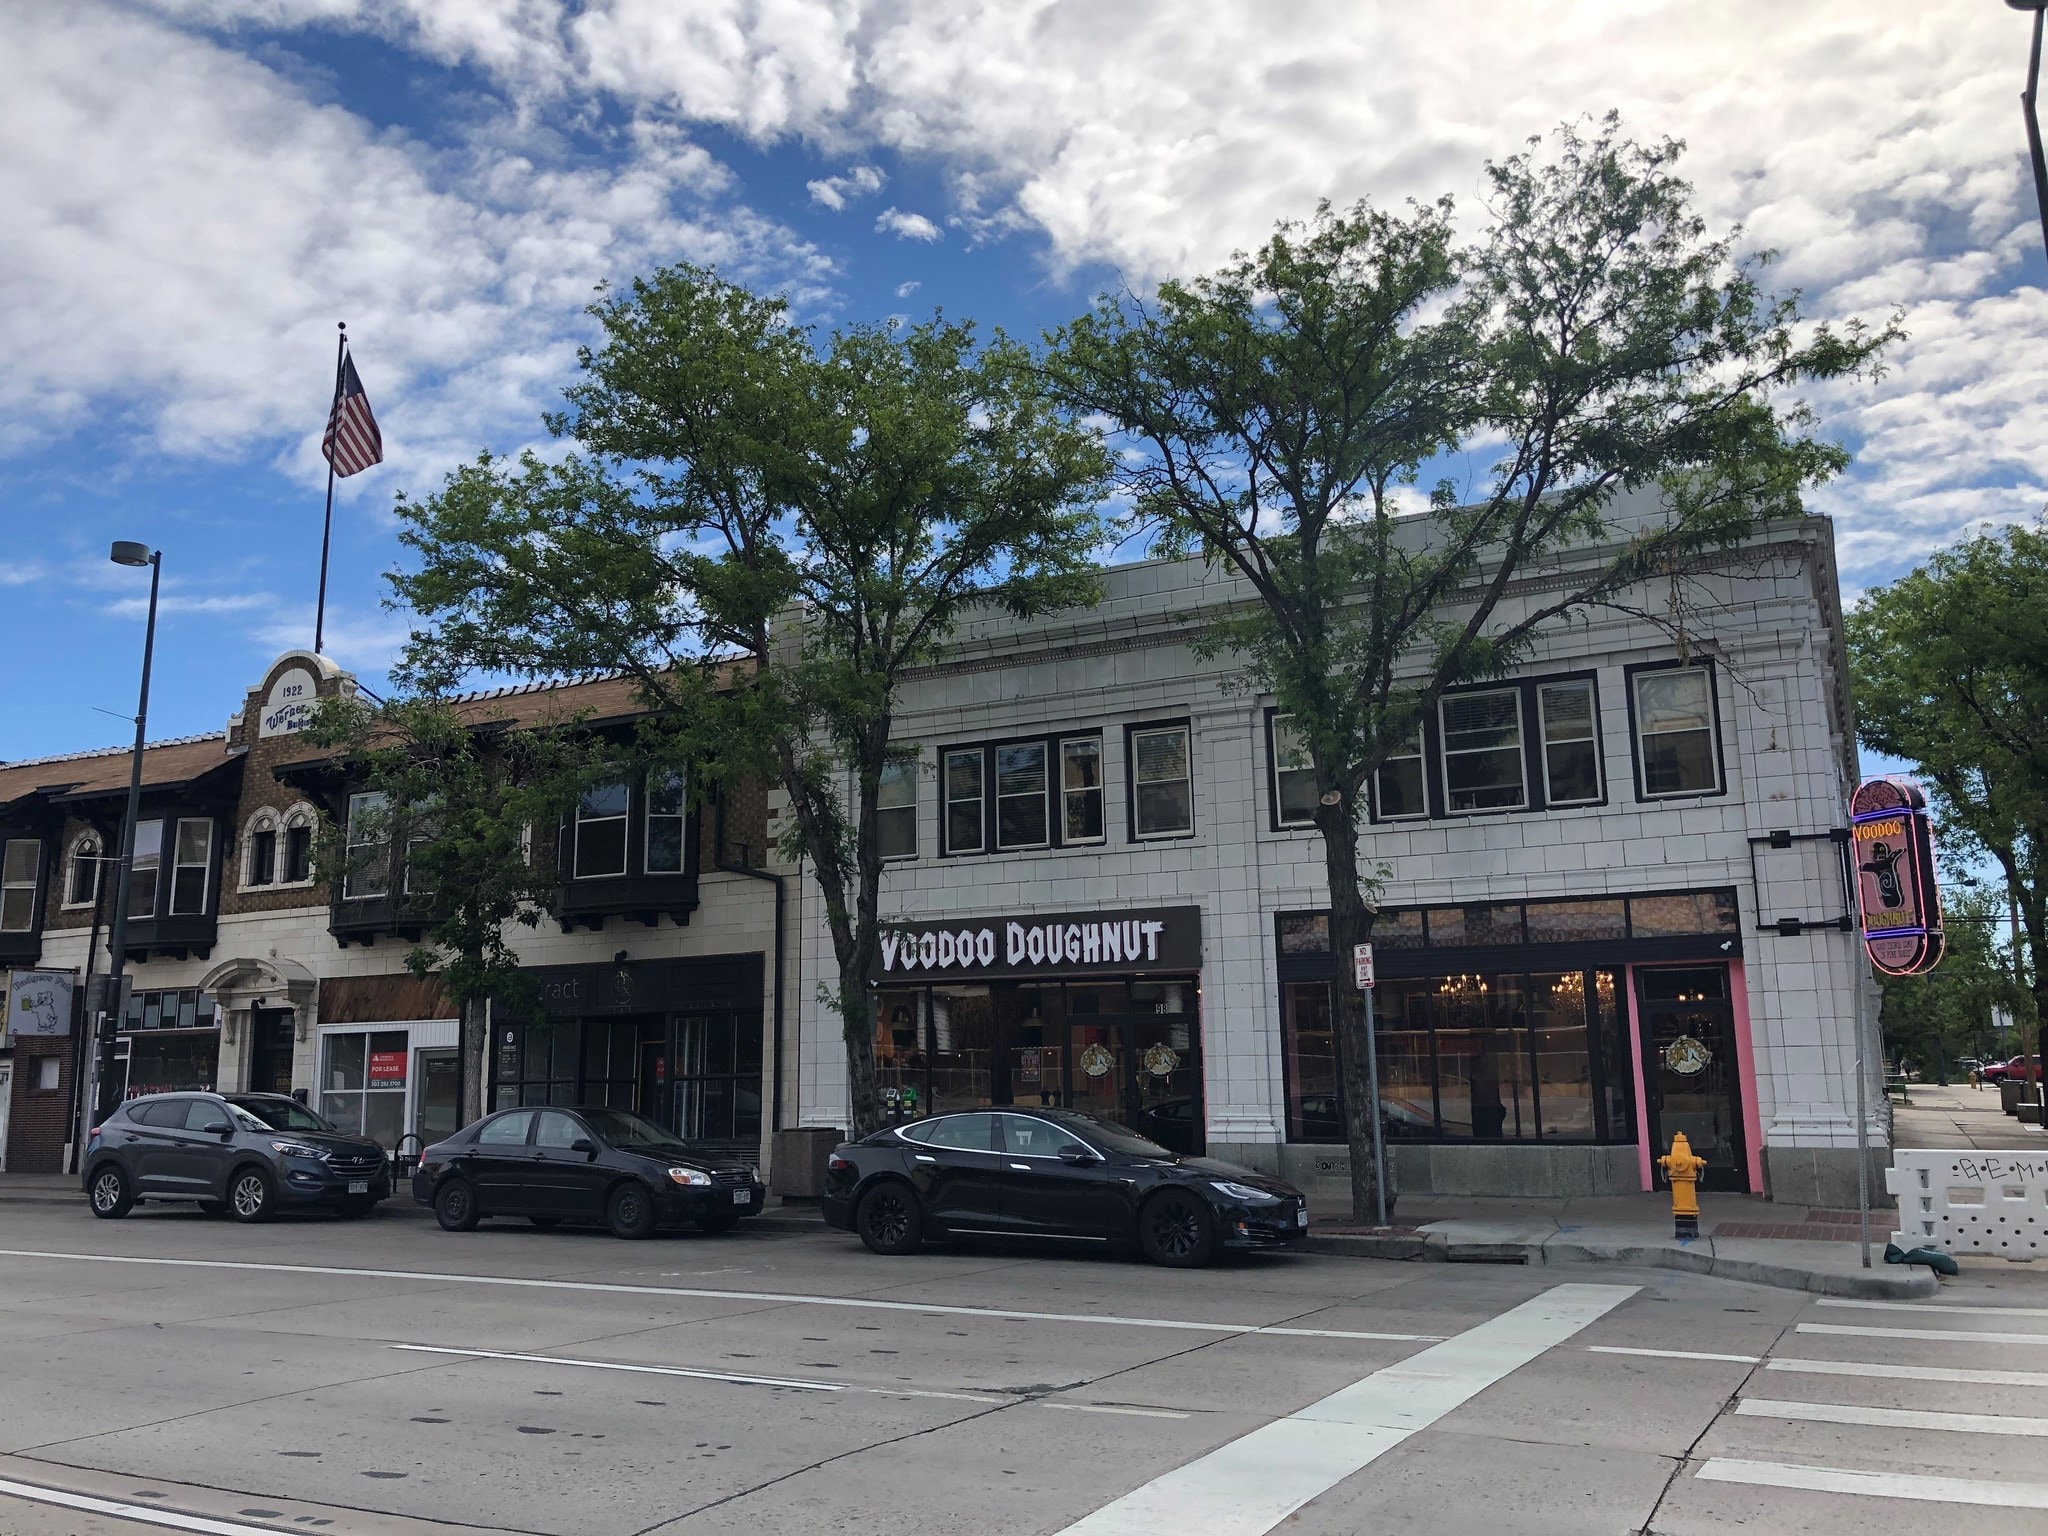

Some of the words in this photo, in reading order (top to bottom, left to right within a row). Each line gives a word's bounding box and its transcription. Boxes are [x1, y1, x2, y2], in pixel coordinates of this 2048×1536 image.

[283, 685, 302, 697] 1922
[1853, 821, 1901, 841] VOODOO
[879, 928, 996, 971] VOODOO
[1006, 919, 1166, 966] DOUGHNUT
[1359, 947, 1367, 955] NO
[1355, 957, 1372, 966] PARKING
[1156, 1004, 1168, 1014] 98
